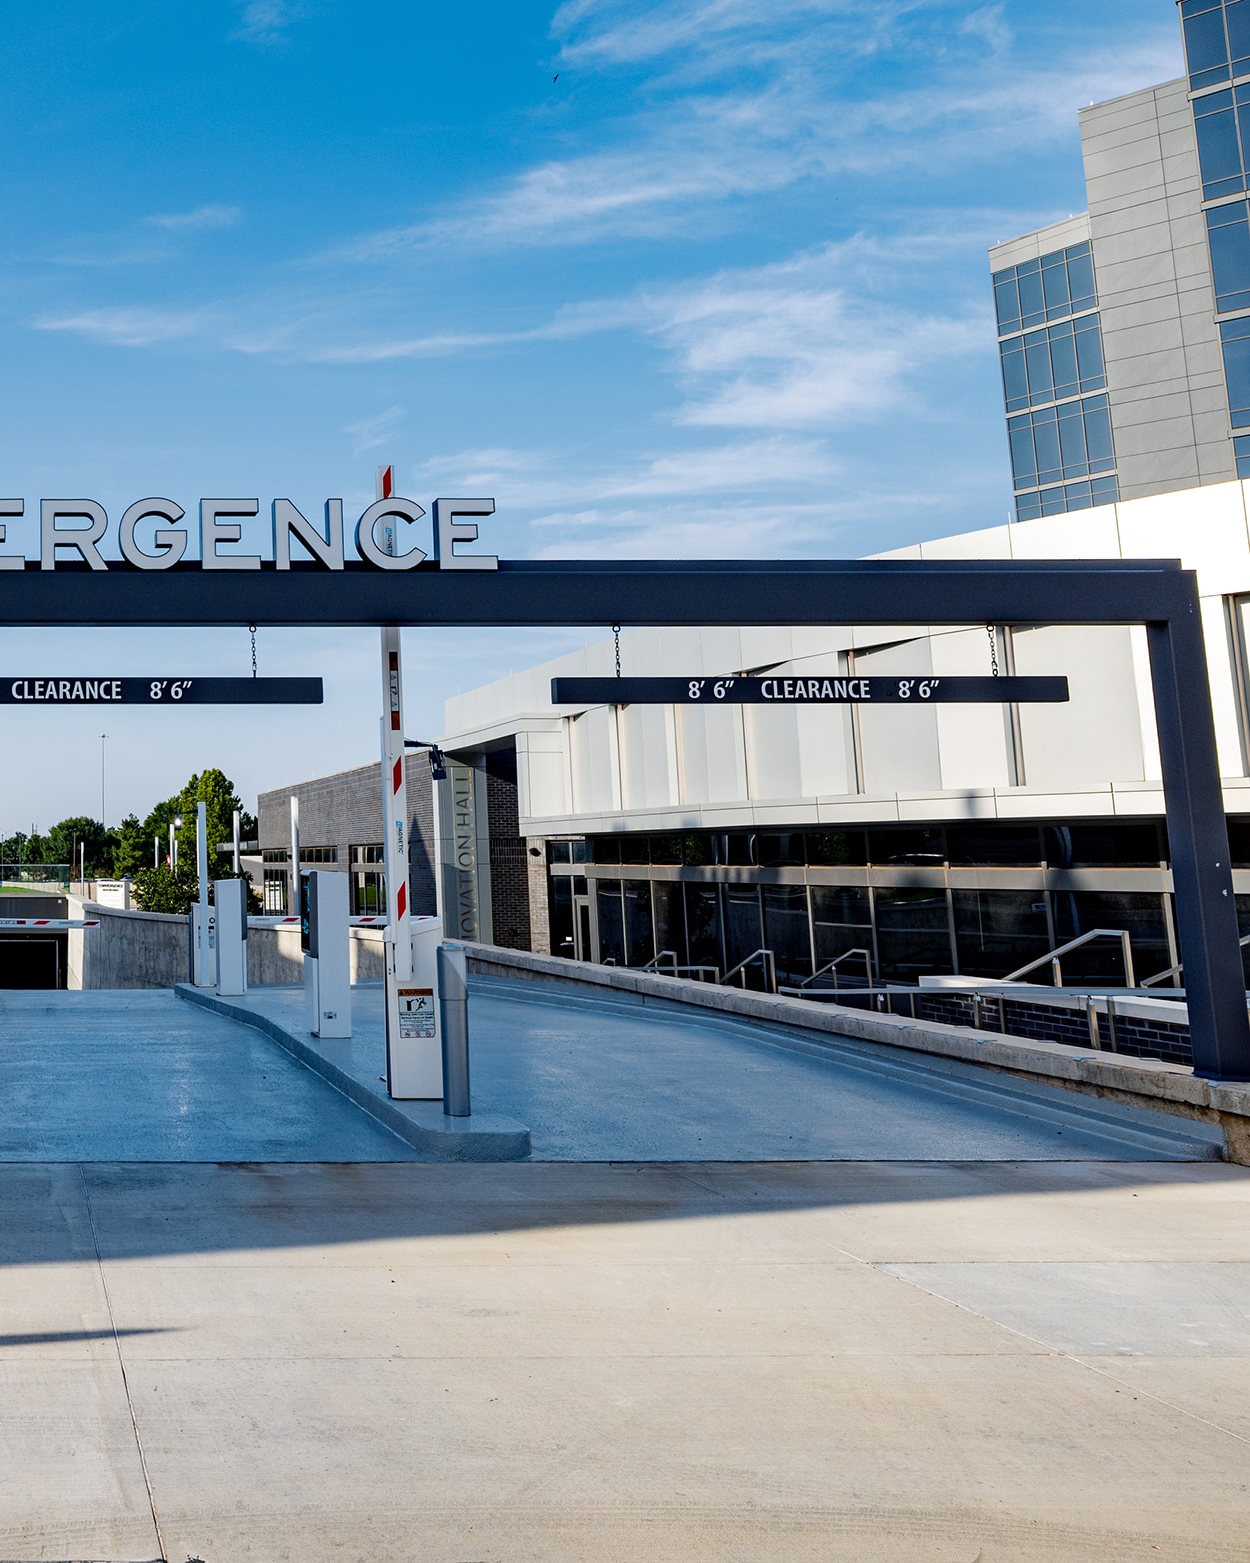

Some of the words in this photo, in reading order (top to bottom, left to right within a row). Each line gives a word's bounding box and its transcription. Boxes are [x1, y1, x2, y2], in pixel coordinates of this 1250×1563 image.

[385, 527, 393, 556] MAGNETI
[11, 680, 122, 700] CLEARANCE
[761, 680, 871, 699] CLEARANCE
[455, 769, 474, 827] HALL
